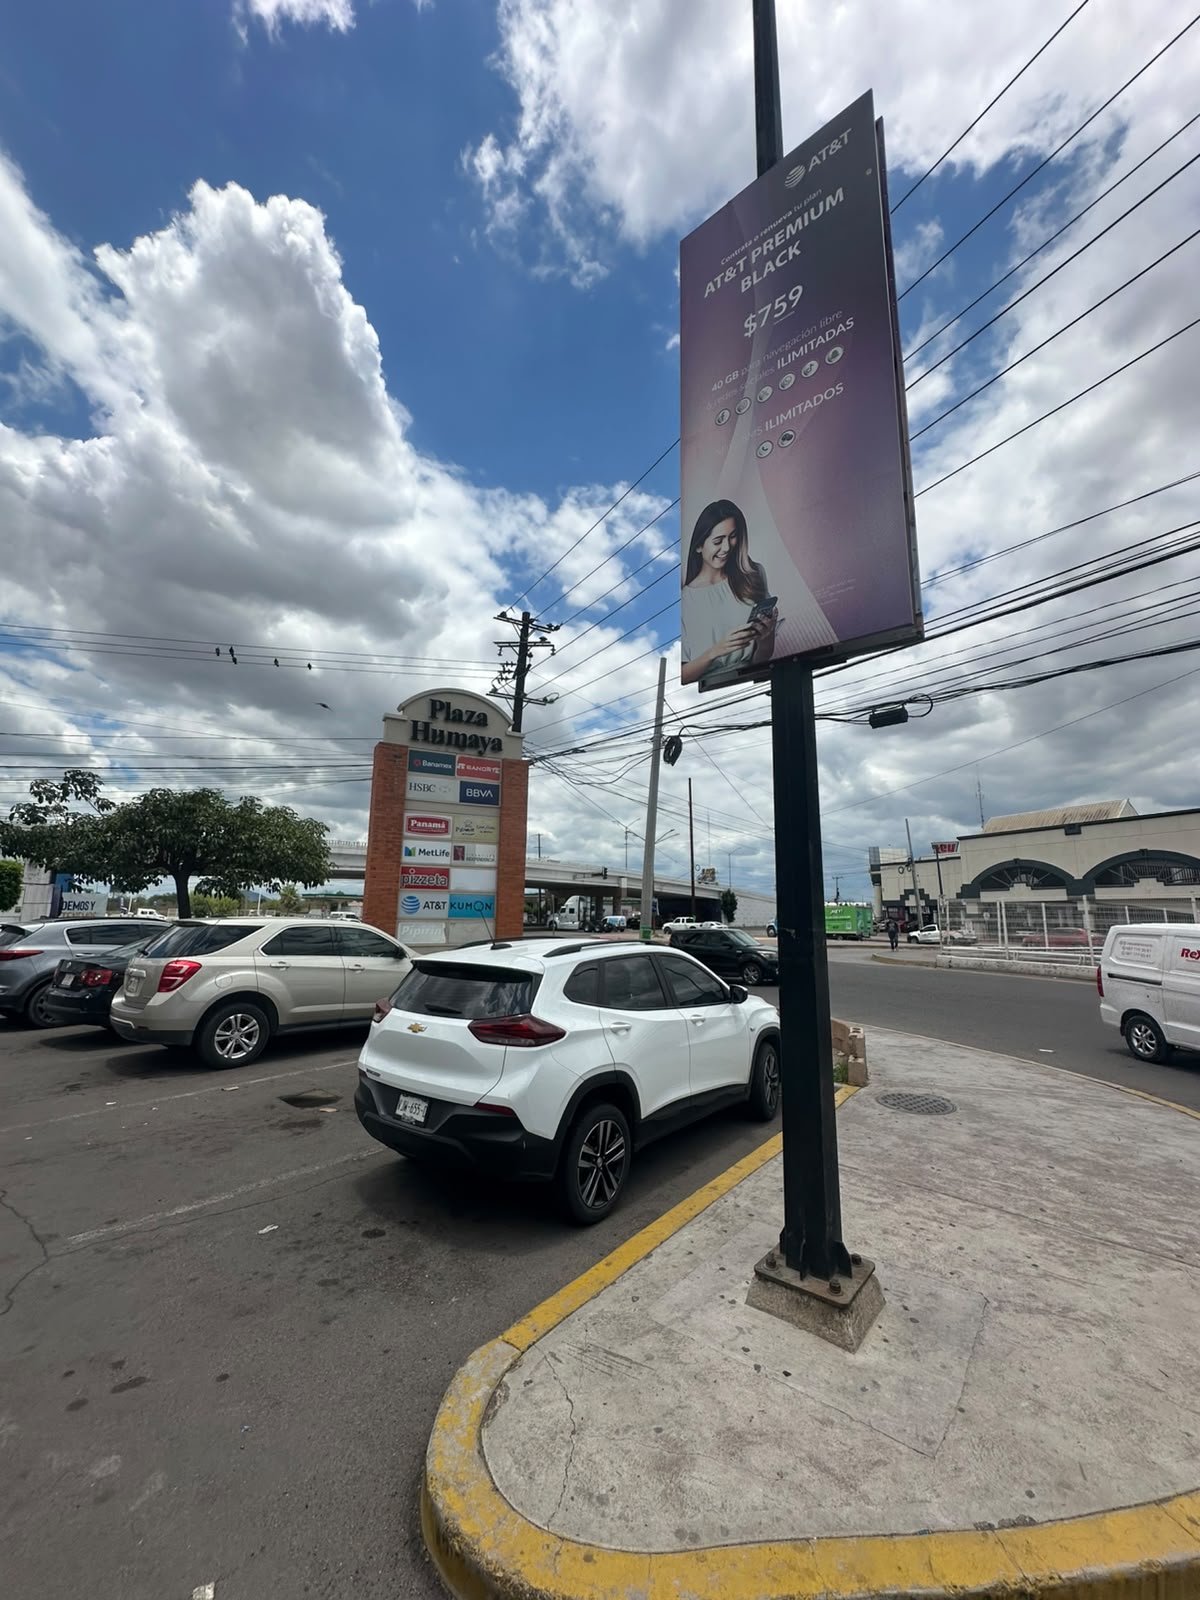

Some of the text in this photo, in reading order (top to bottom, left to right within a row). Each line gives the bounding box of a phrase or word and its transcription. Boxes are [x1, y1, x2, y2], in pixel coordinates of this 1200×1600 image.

[808, 128, 852, 172] AT&T
[721, 239, 752, 266] Contrata
[760, 210, 793, 237] renueva
[794, 203, 803, 213] tu
[804, 188, 822, 207] plan
[704, 187, 845, 298] AT&T PREMIUM
[741, 240, 801, 293] BLACK
[743, 285, 804, 338] $759
[711, 380, 724, 392] 40
[725, 370, 740, 384] GB
[819, 311, 843, 329] libre
[777, 317, 855, 369] ILIMITADAS
[765, 382, 844, 432] ILIMITADOS
[429, 698, 488, 727] Plaza
[410, 720, 503, 756] Humaya
[422, 760, 452, 769] Banamex
[466, 765, 500, 774] BANORTE
[408, 782, 437, 793] HSBC
[466, 788, 493, 798] BBVA
[410, 819, 446, 829] Panamá
[418, 848, 450, 858] MetLife
[401, 868, 448, 888] pizzeta
[423, 901, 447, 911] AT&T
[450, 900, 493, 912] KUMON
